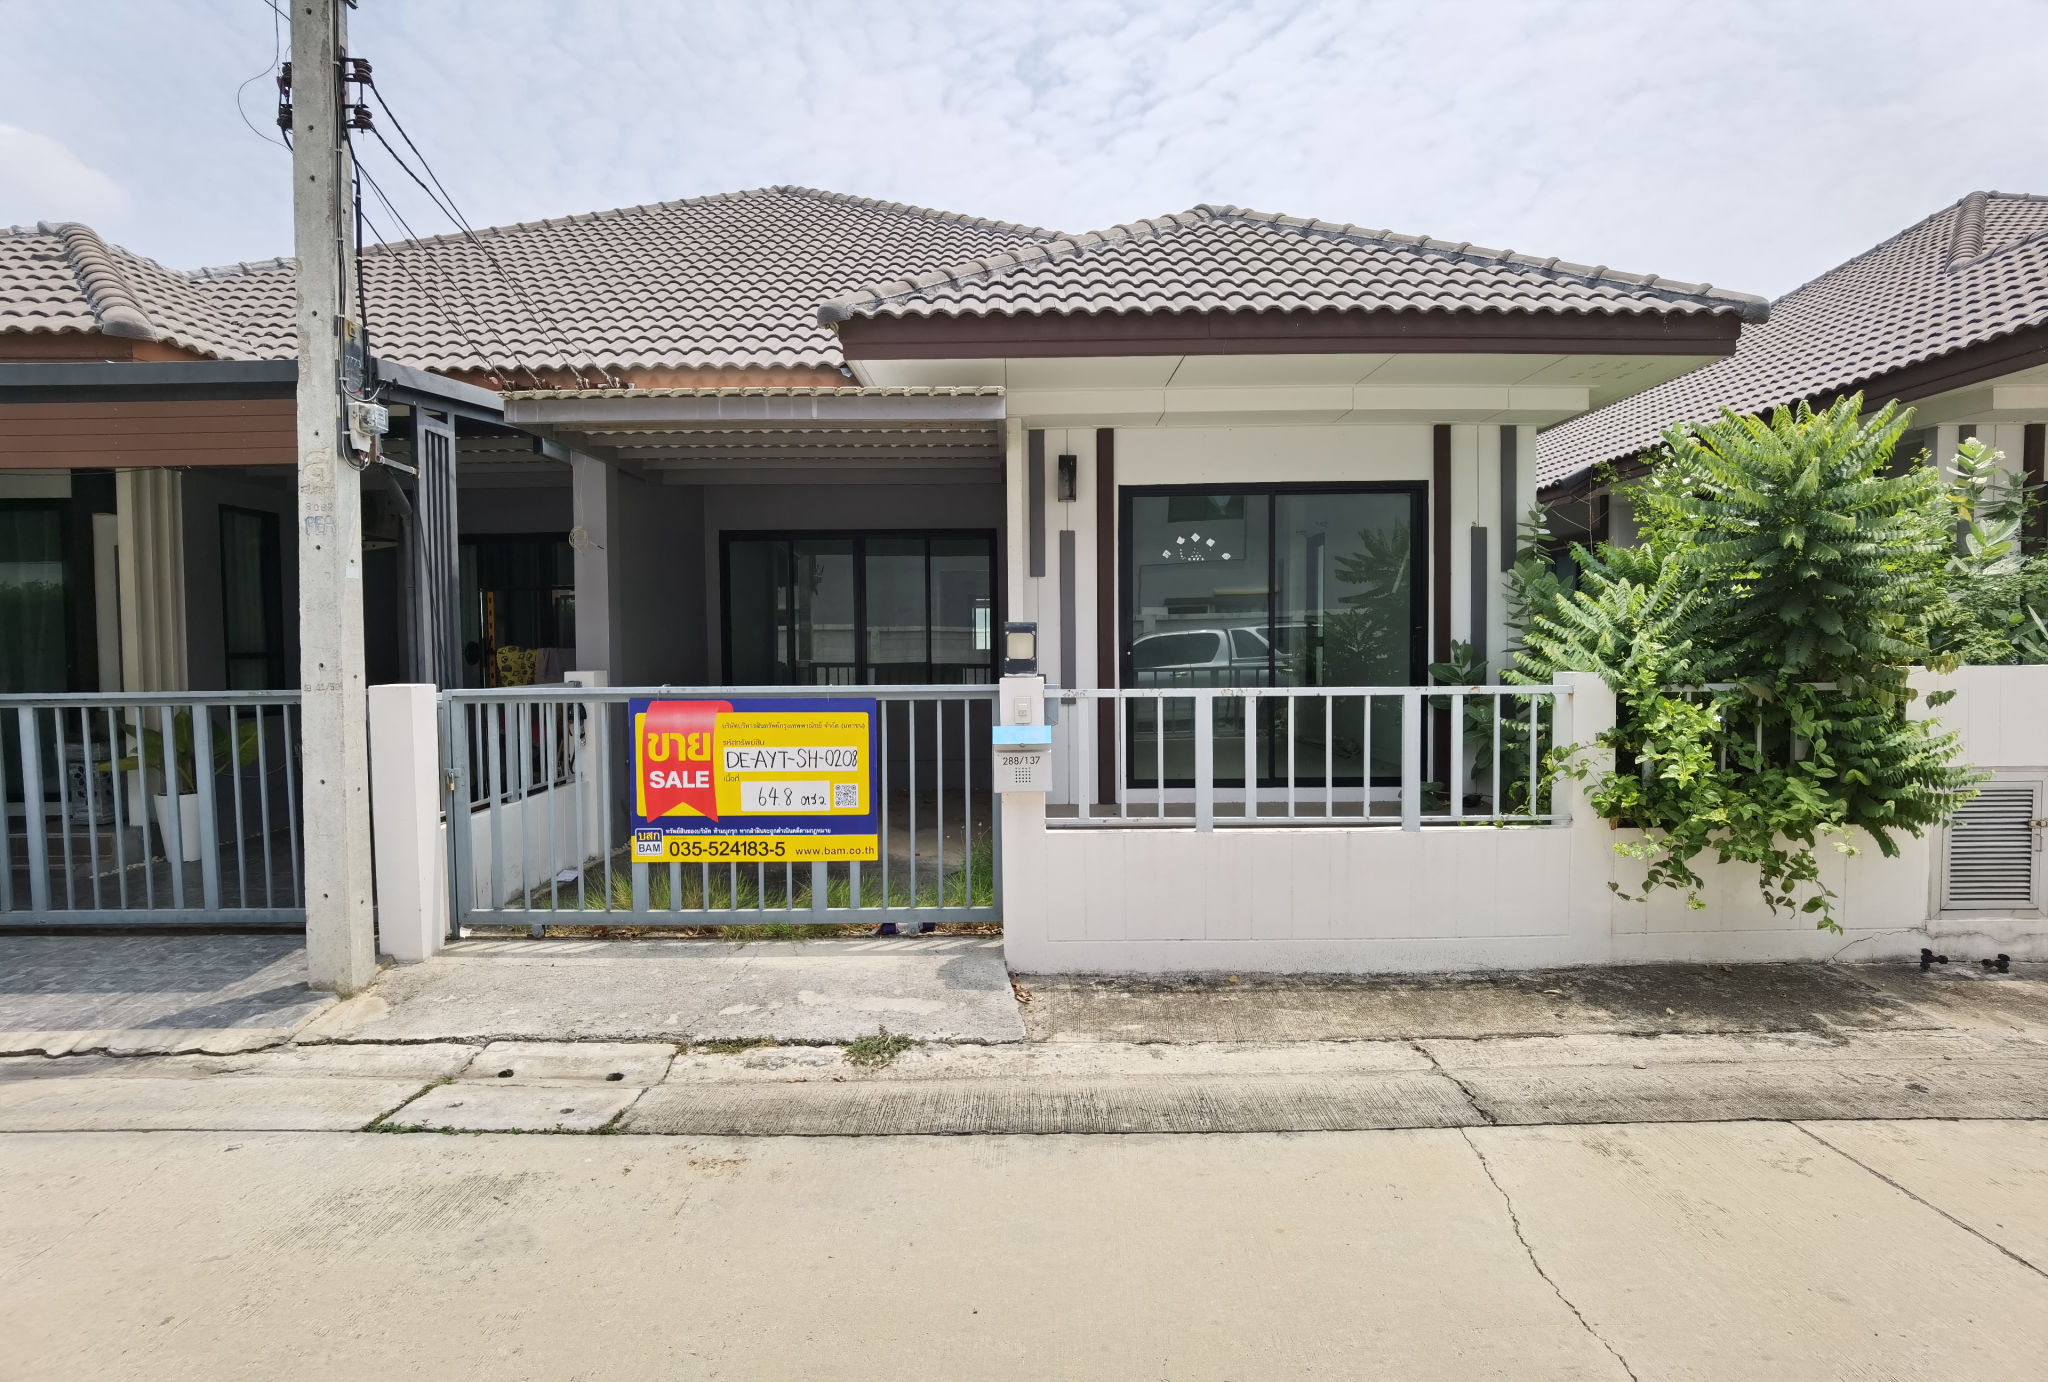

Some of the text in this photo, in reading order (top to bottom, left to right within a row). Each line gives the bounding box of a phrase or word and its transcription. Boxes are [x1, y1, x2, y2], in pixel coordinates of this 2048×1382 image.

[647, 732, 711, 762] ขาย
[726, 748, 858, 769] DE-AYT-SH-0208
[1002, 756, 1041, 766] 288/137
[649, 770, 710, 788] SALE
[638, 831, 660, 841] บสก
[639, 843, 661, 853] BAM
[669, 841, 875, 857] 035-524183-5 www.bam.co.th
